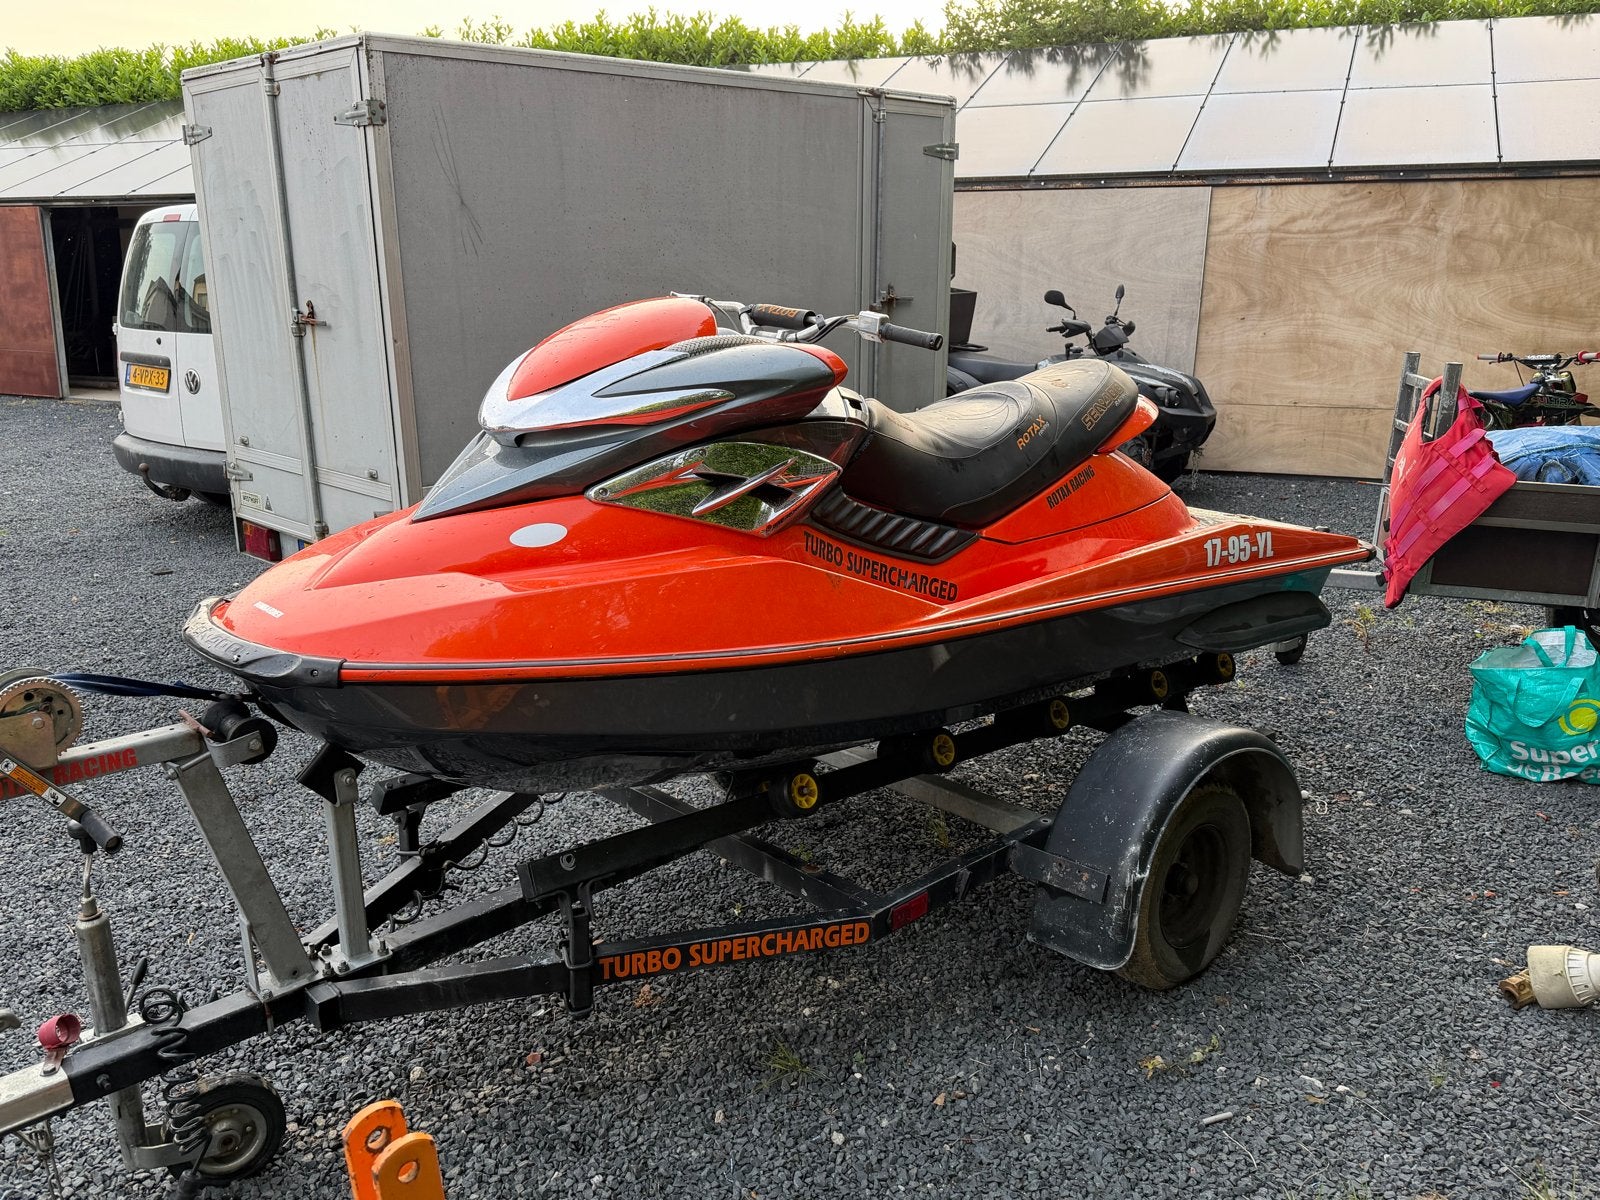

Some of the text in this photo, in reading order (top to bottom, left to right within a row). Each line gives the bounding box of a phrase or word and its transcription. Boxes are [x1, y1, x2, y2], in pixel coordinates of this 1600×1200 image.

[132, 367, 166, 387] 4-VPX-33
[1016, 414, 1046, 450] ROTAX
[1046, 464, 1096, 510] ROTAX RACING
[803, 530, 959, 602] TURBO SUPERCHARGED
[1203, 531, 1274, 567] 17-95-YL
[52, 747, 138, 786] RACING
[1510, 739, 1599, 765] Super
[600, 922, 870, 980] TURBO SUPERCHARGED
